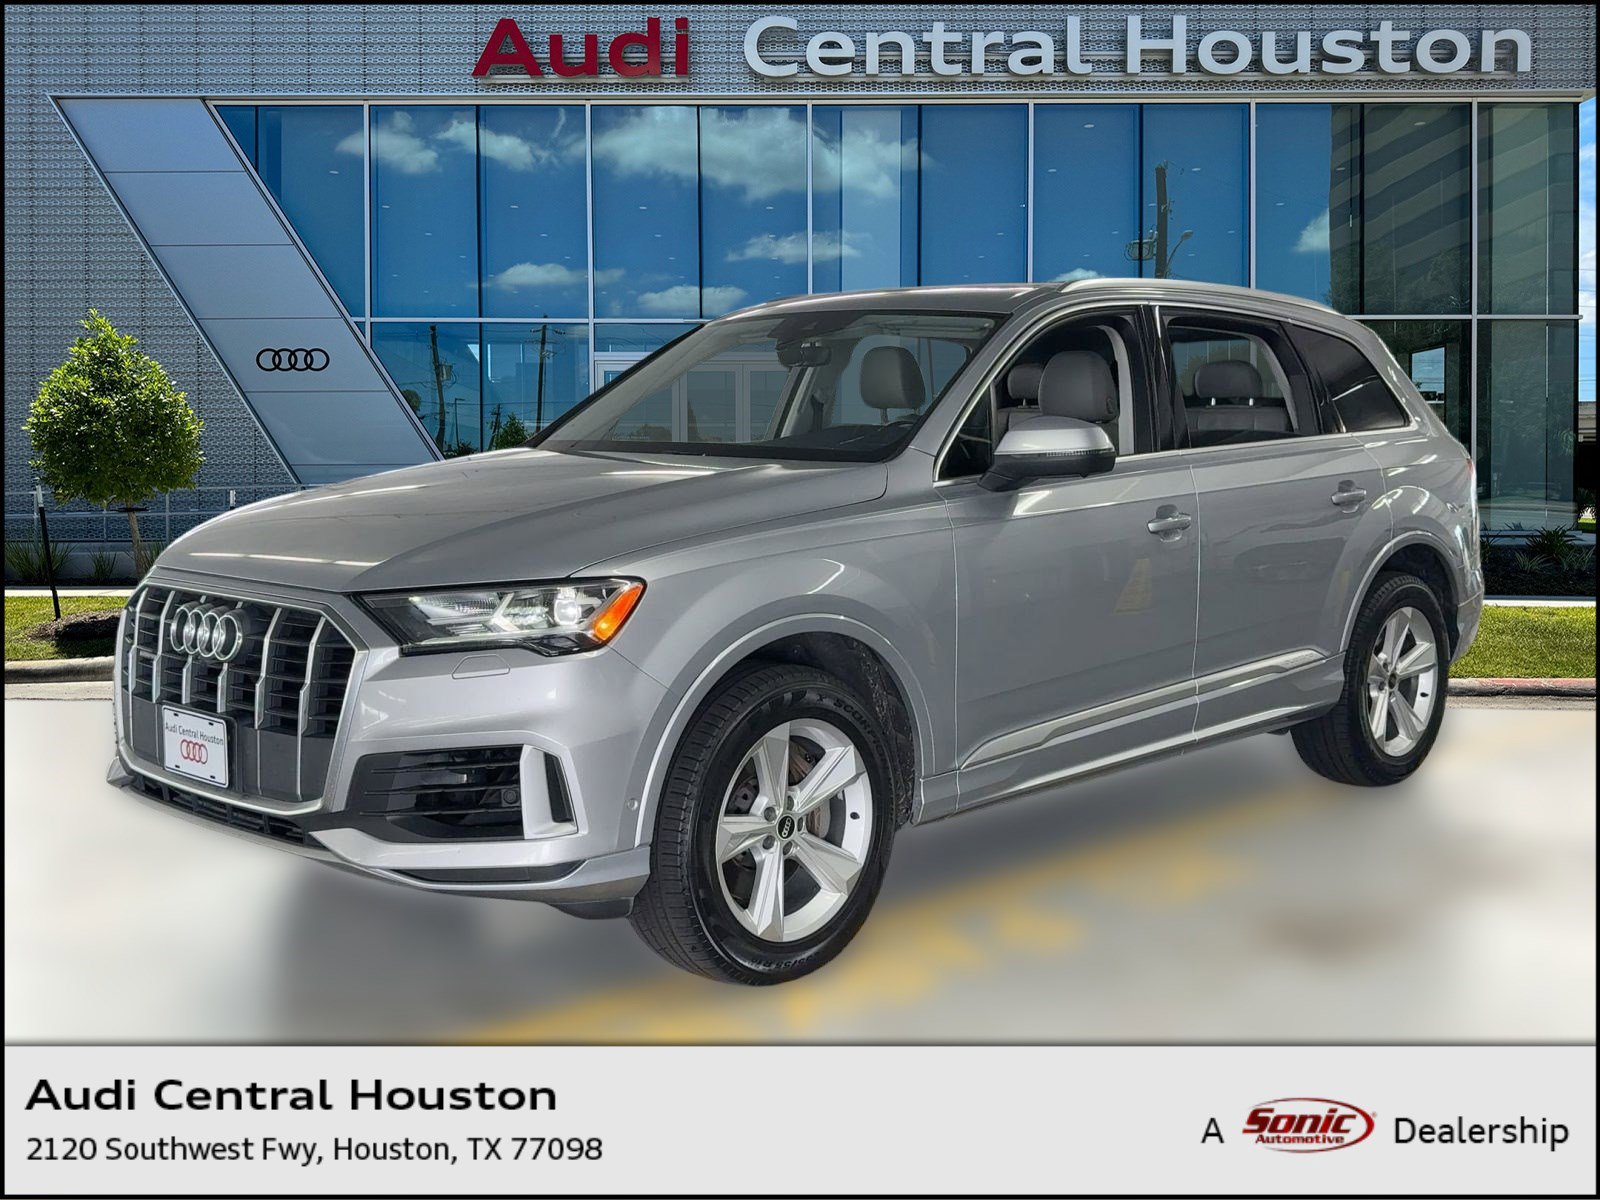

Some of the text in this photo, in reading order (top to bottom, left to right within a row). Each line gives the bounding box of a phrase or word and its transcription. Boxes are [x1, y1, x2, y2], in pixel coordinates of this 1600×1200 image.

[473, 14, 1532, 79] Audi Central Houston
[165, 722, 225, 746] Audi Central Houston
